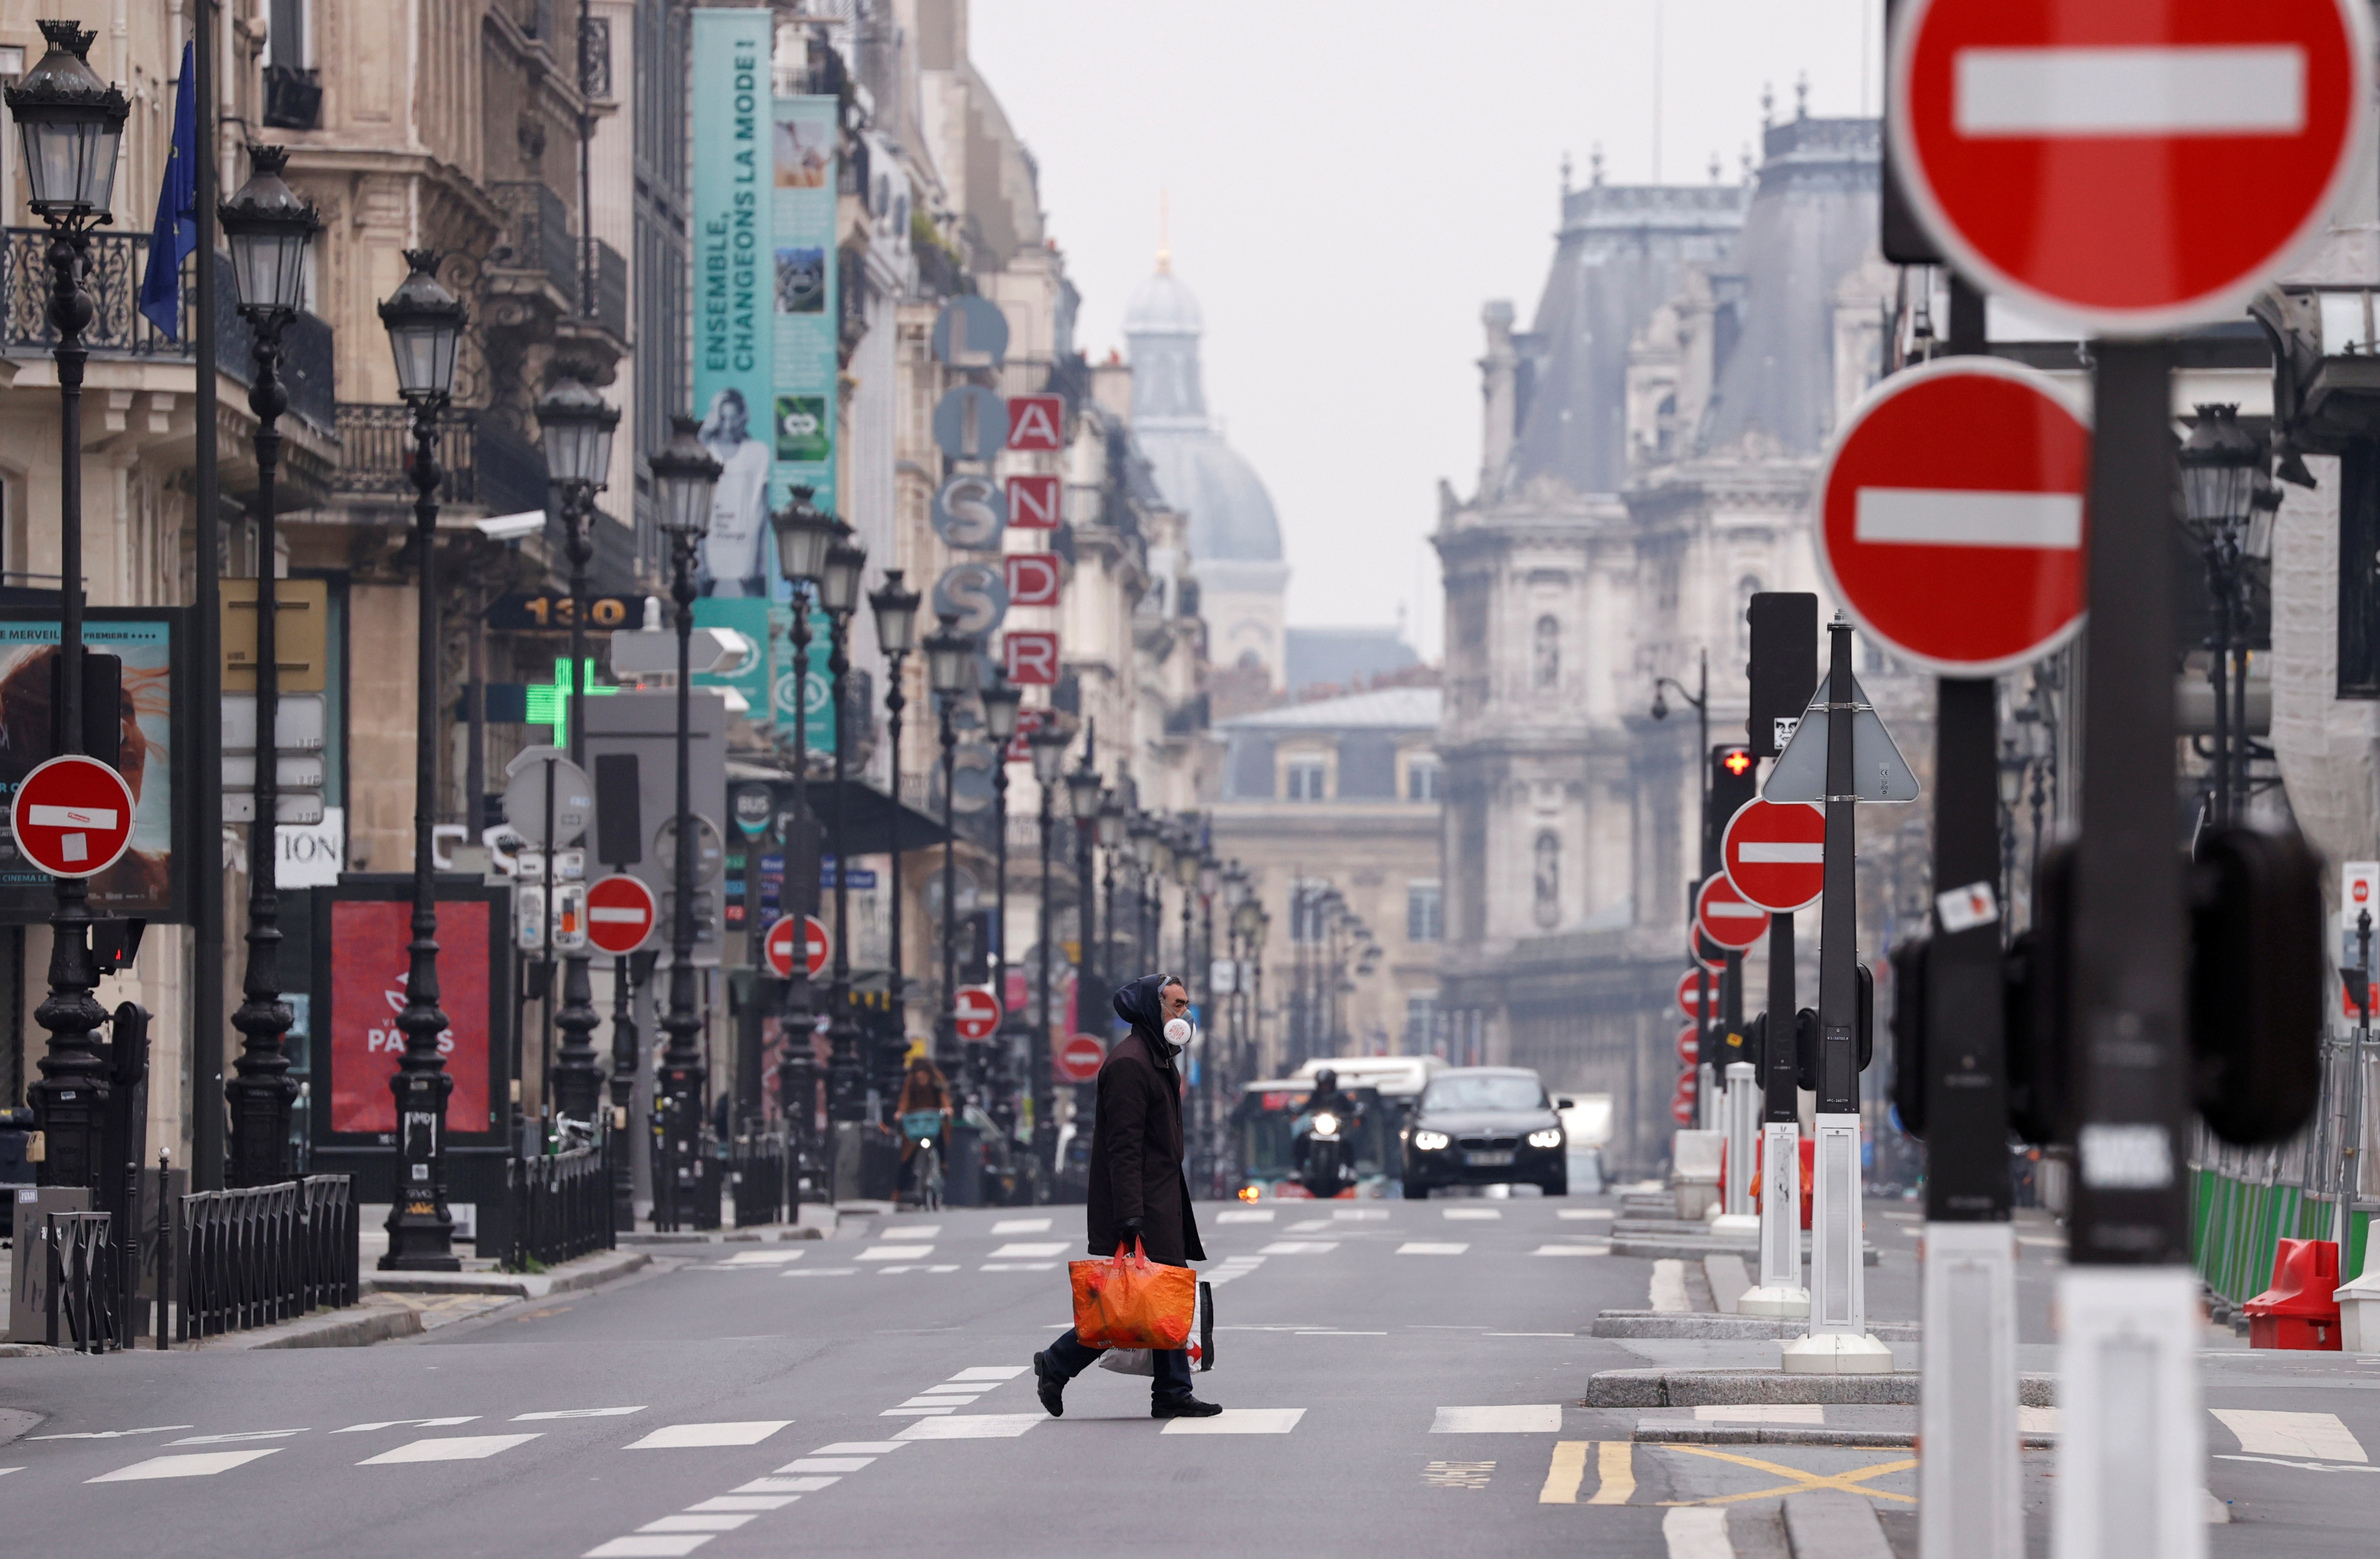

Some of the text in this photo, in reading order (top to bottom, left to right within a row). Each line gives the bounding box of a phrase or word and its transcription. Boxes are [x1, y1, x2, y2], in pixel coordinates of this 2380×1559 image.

[734, 52, 755, 140] MODE
[734, 149, 755, 184] LA
[706, 212, 730, 372] ENSEMBLE,
[734, 192, 755, 372] CHANGEONS
[941, 307, 997, 812] LISSC
[9, 630, 60, 639] MERVEIL
[737, 795, 769, 814] BUS
[284, 832, 338, 863] ION
[368, 1029, 454, 1052] PAS
